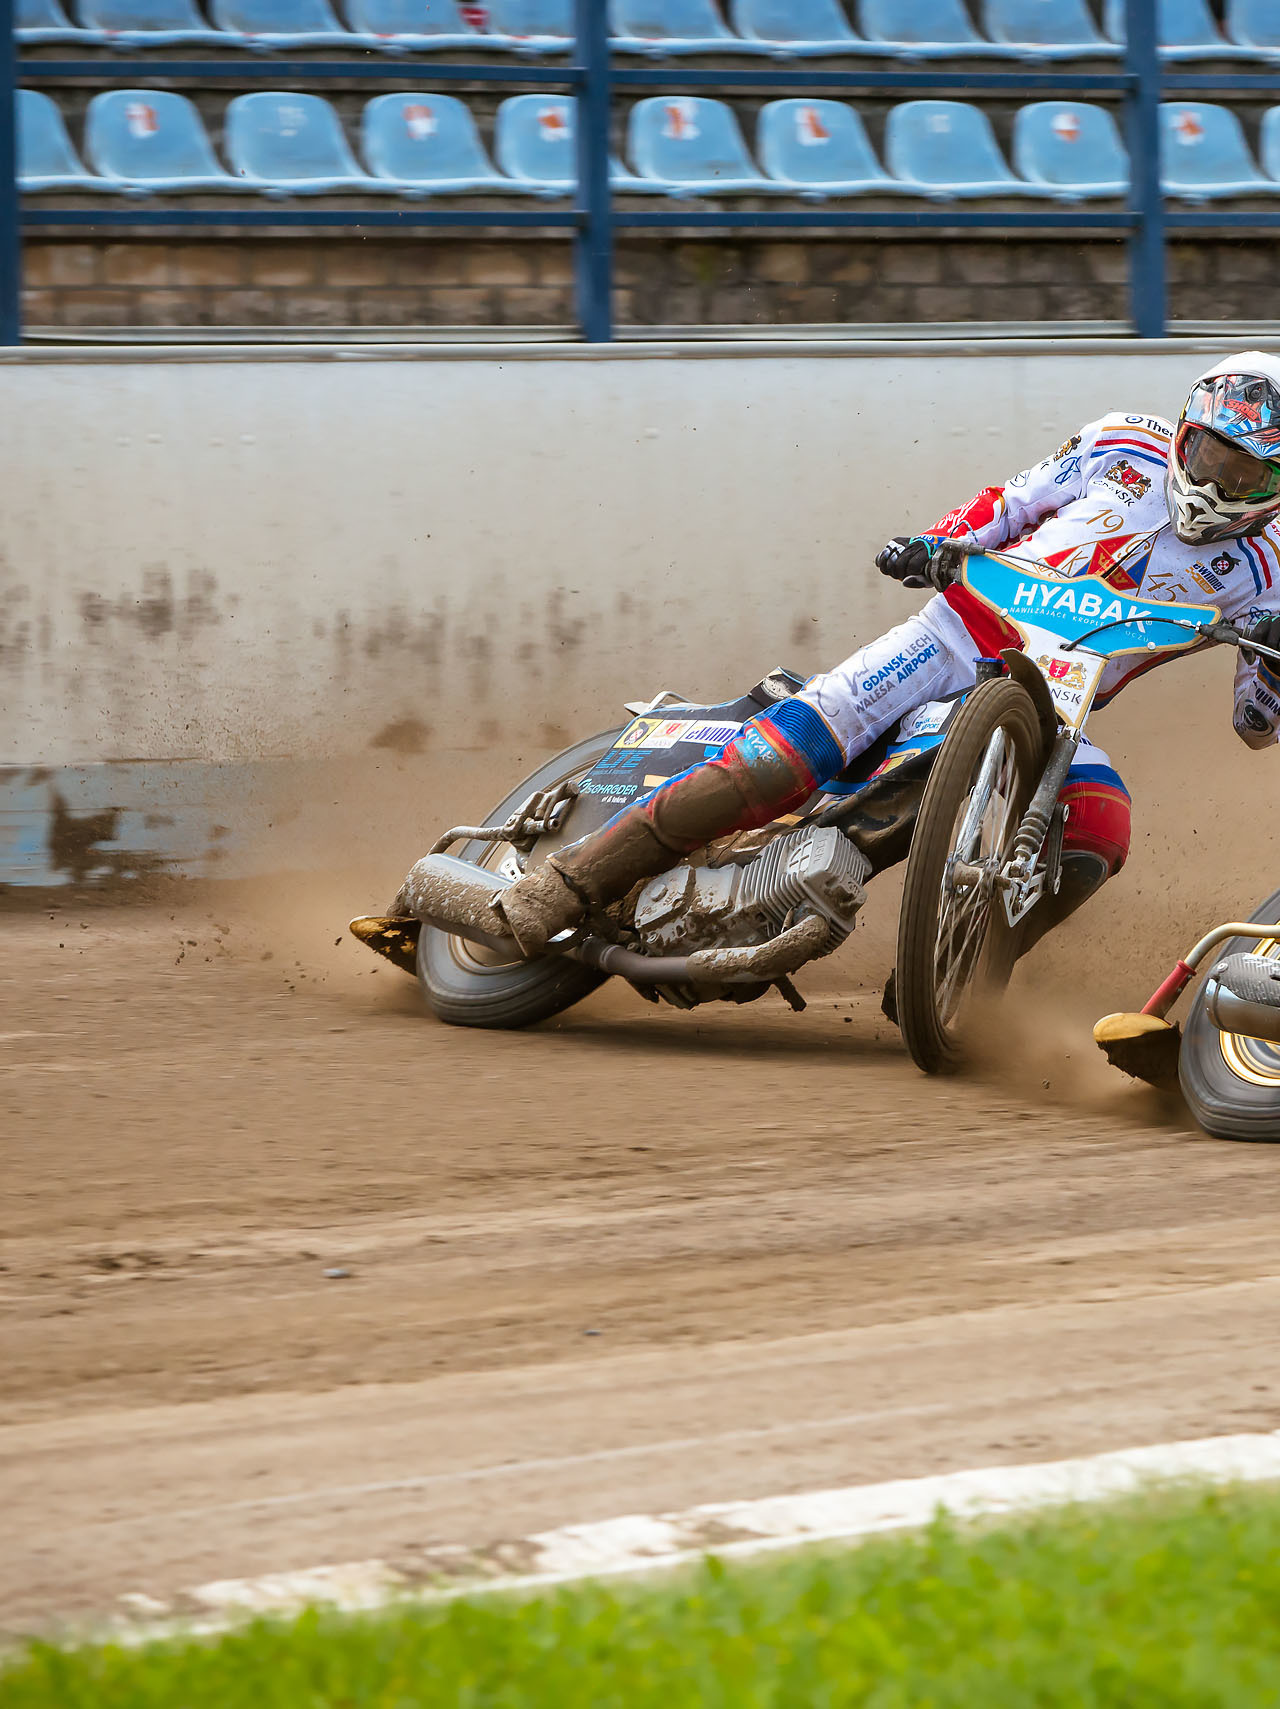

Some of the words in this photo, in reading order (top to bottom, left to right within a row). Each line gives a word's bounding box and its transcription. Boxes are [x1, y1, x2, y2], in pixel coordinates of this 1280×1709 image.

[1086, 509, 1125, 534] 19
[1147, 572, 1189, 602] 45
[1013, 582, 1153, 634] HYABAK
[862, 652, 909, 692] GDANSK
[904, 633, 933, 657] LECH
[854, 679, 896, 715] WALESA
[595, 750, 654, 769] LTE
